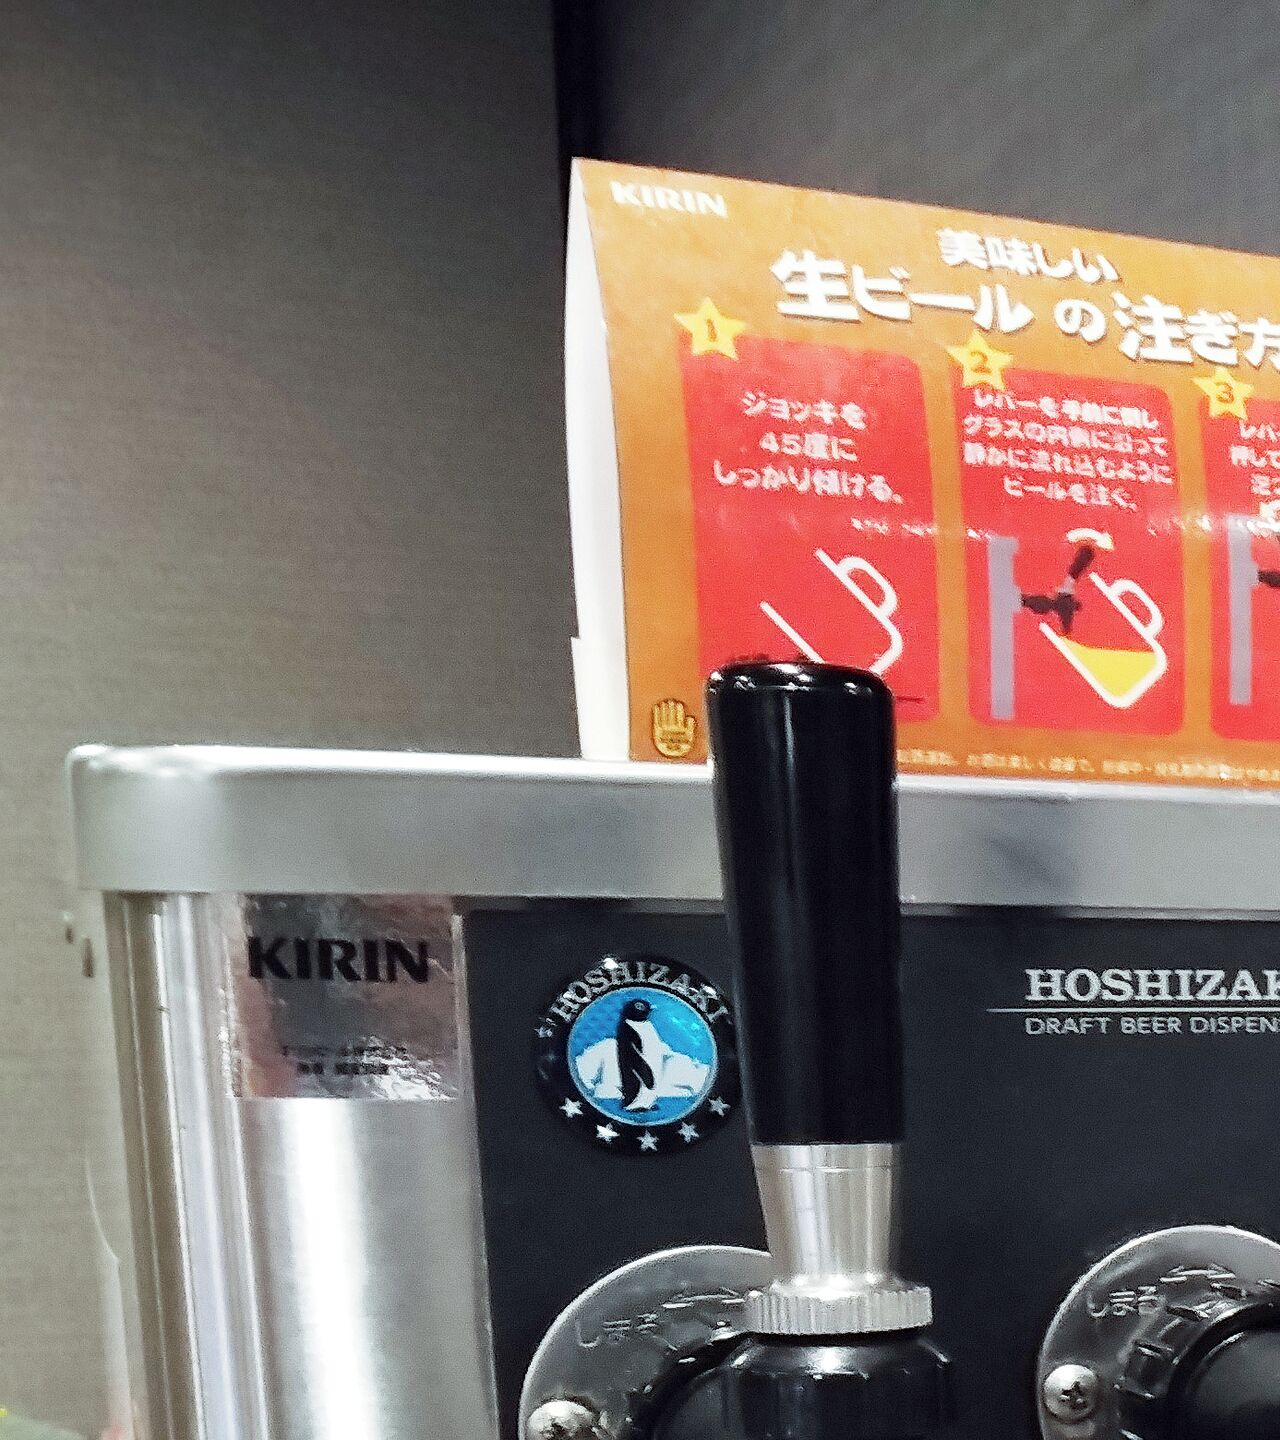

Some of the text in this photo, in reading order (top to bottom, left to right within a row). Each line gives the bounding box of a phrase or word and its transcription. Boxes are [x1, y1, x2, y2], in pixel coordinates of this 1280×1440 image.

[610, 181, 728, 218] KIRIN
[936, 228, 1121, 284] 美味しい
[969, 350, 992, 374] 2
[1215, 383, 1235, 404] 3
[759, 431, 858, 461] 45度に
[248, 937, 431, 983] KIRIN
[550, 956, 730, 1024] HOSHIZAKI
[1024, 1016, 1111, 1035] DRAFT
[1120, 1016, 1183, 1035] BEER
